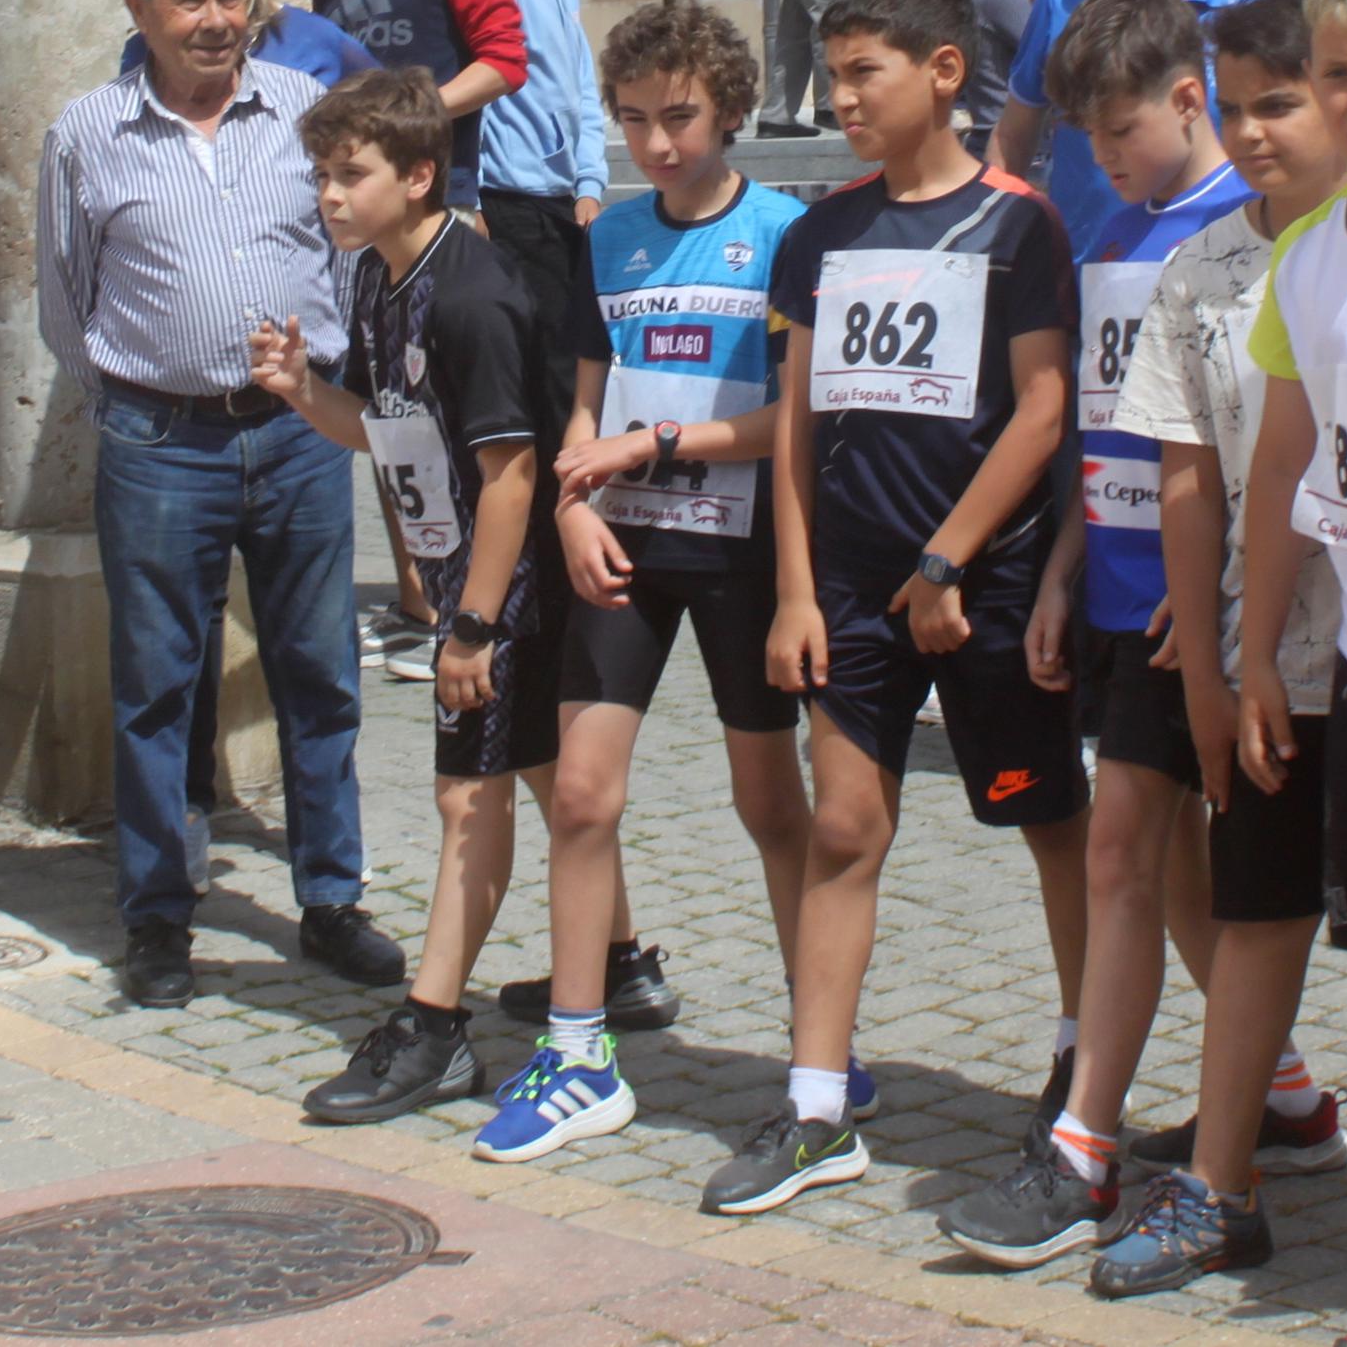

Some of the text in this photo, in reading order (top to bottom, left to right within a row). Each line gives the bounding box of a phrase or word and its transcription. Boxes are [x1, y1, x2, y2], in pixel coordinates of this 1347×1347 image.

[354, 18, 413, 47] das
[609, 296, 678, 319] LAGUNA
[842, 301, 938, 368] 862
[1100, 318, 1142, 385] 85
[827, 387, 901, 405] Caja España
[995, 769, 1030, 787] NIKE
